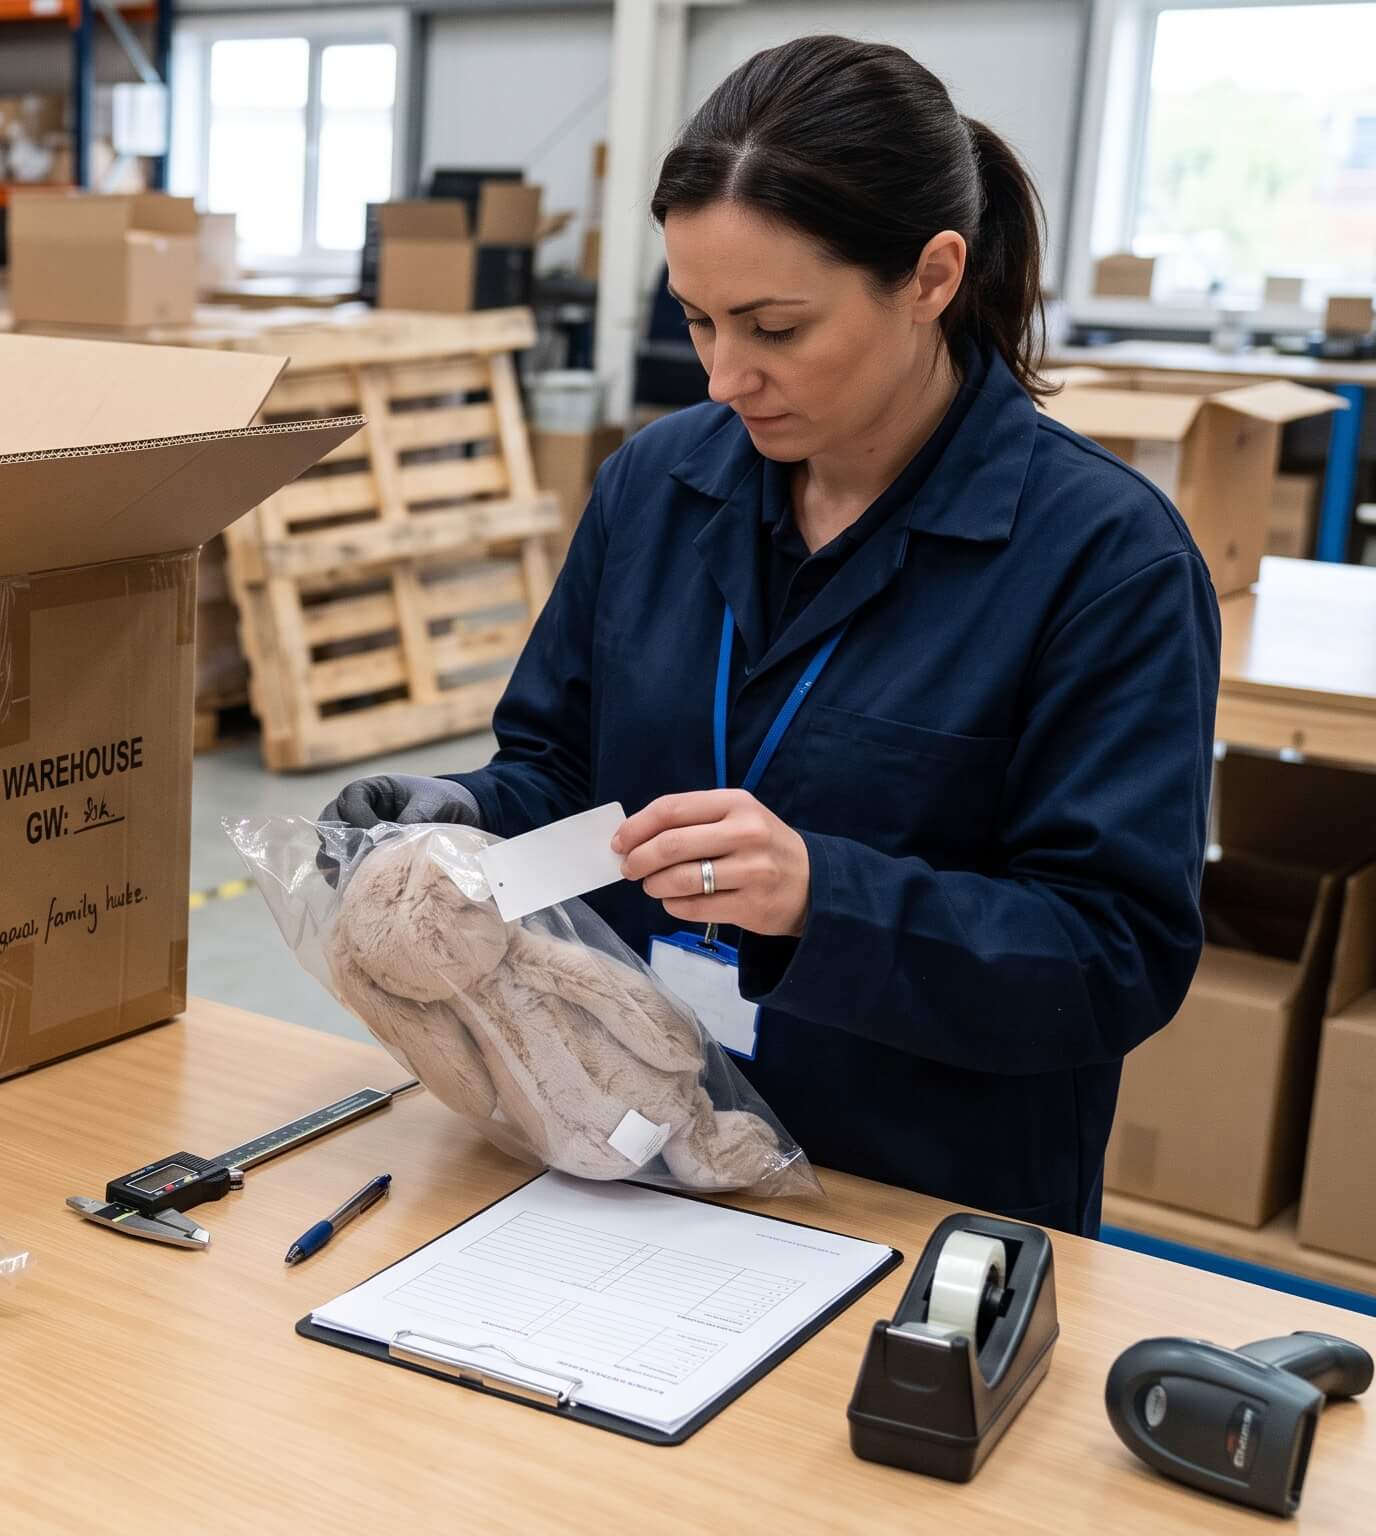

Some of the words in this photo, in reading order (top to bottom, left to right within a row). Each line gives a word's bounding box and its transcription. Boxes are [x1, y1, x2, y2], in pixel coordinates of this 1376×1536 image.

[3, 736, 143, 801] WAREHOUSE
[26, 805, 69, 845] GW:
[44, 893, 97, 945] family
